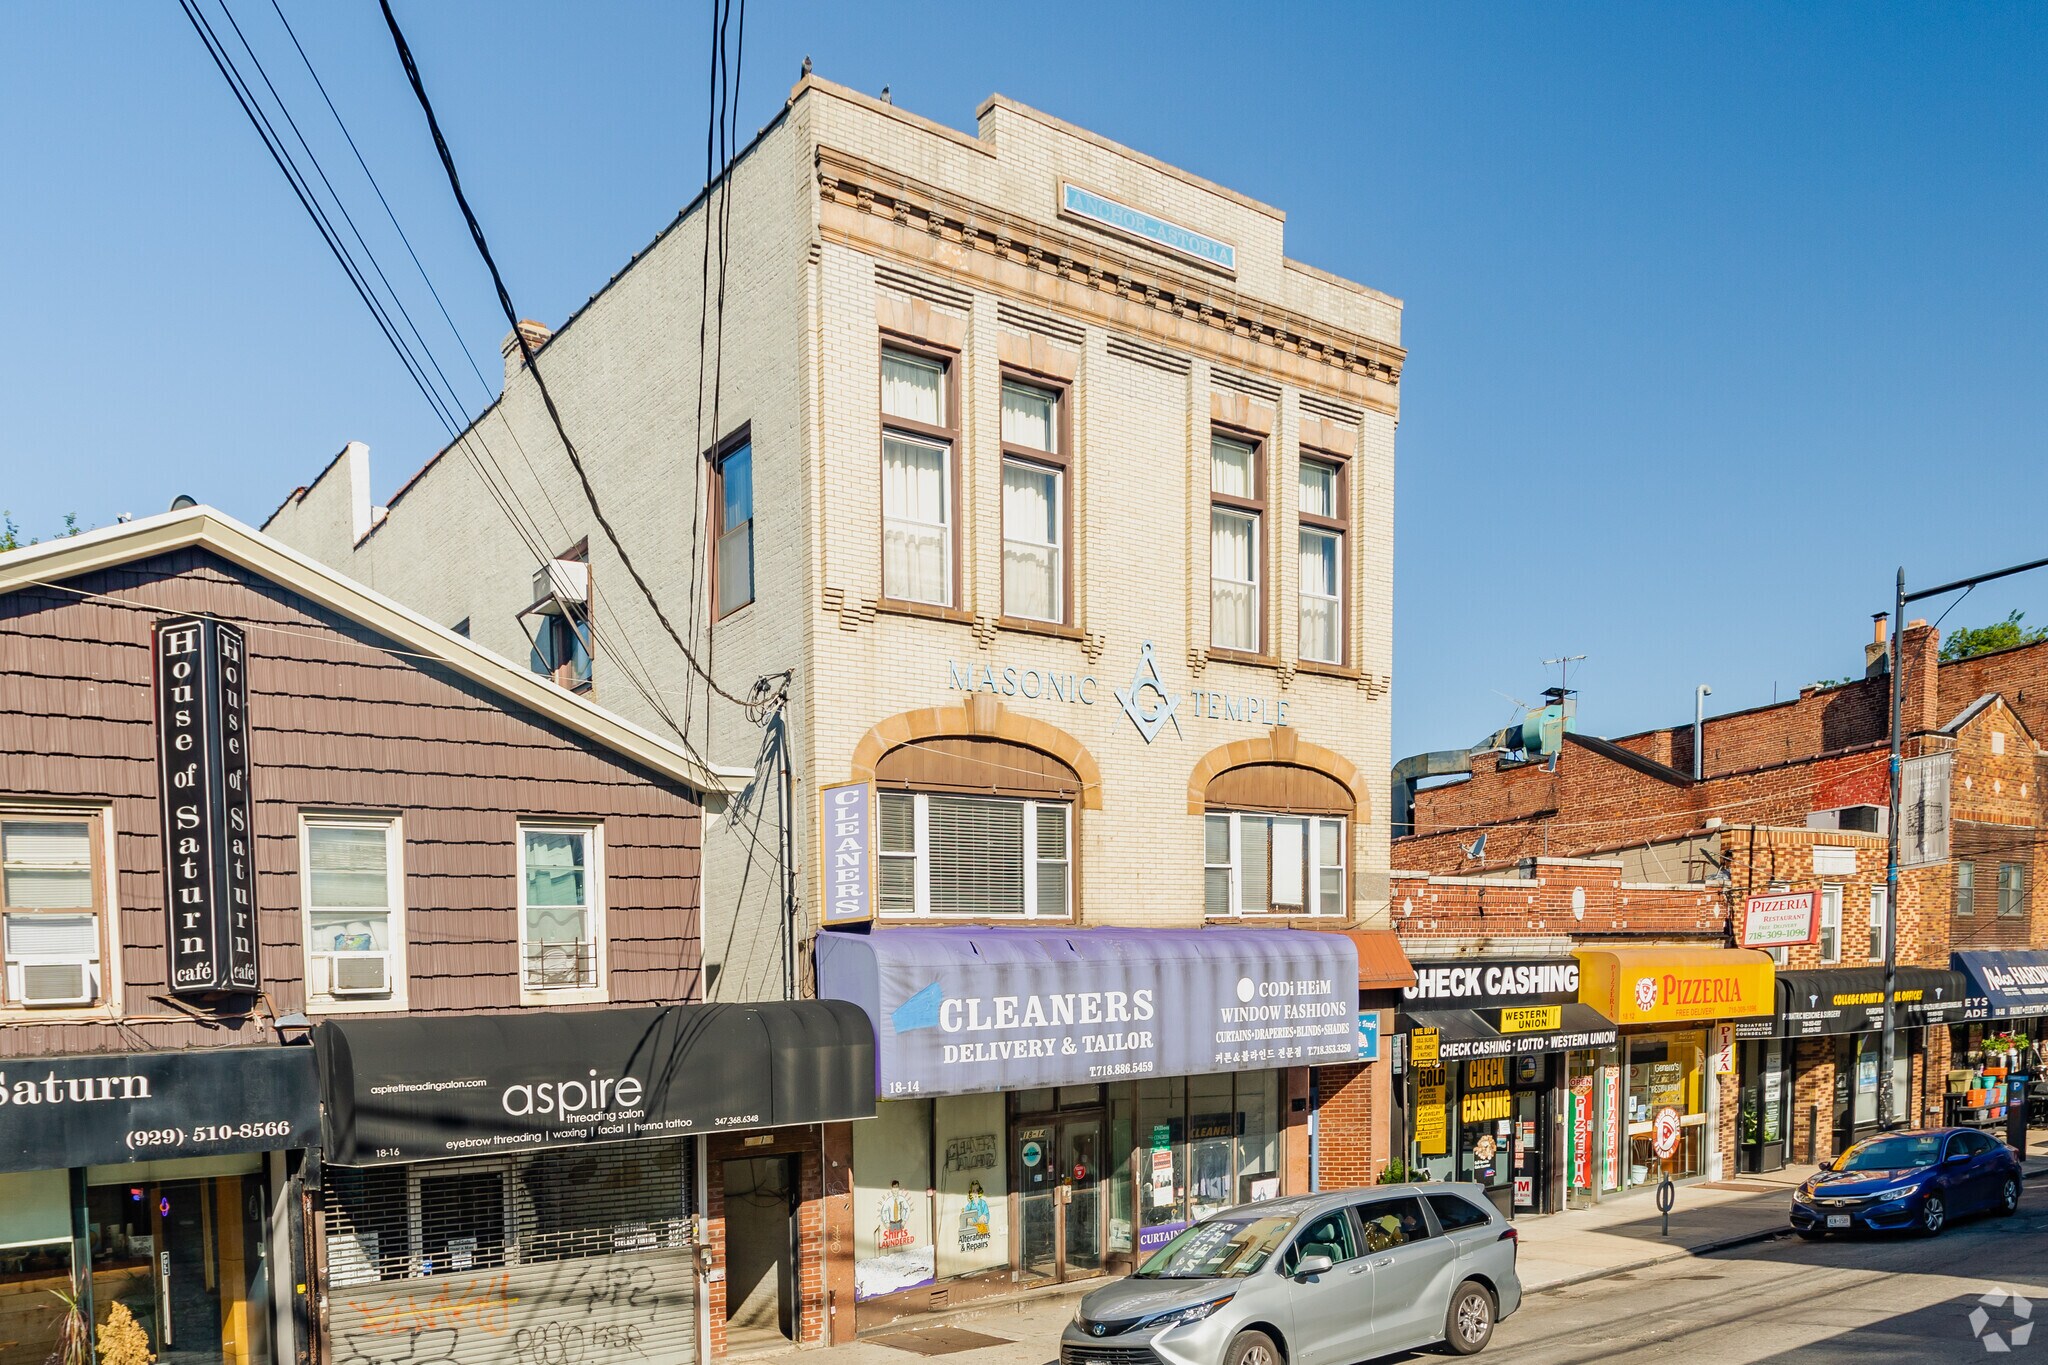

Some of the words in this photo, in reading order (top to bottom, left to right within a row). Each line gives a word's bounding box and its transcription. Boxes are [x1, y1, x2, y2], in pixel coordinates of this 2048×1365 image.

[165, 628, 199, 751] House
[220, 634, 241, 755] House
[948, 659, 1097, 705] MASONIC
[1192, 689, 1290, 726] TEMPLE
[174, 764, 198, 788] of
[229, 769, 242, 791] of
[834, 790, 864, 914] CLEANERS
[175, 805, 206, 954] Saturn
[229, 808, 251, 953] Saturn
[1751, 898, 1808, 913] PIZZERIA
[177, 961, 212, 982] café
[233, 964, 255, 981] café
[1485, 965, 1578, 995] CASHING
[1662, 974, 1742, 1006] PIZZERIA
[1833, 993, 1859, 1006] COLLEGE
[1860, 992, 1878, 1005] POINT
[940, 989, 1154, 1033] CLEANERS
[1221, 1005, 1281, 1023] WINDOW
[1284, 1002, 1346, 1020] FASHIONS
[1505, 1009, 1548, 1020] WESTERN
[1414, 1027, 1423, 1035] WE
[1518, 1019, 1547, 1029] UNION
[943, 1037, 1057, 1064] DELIVERY
[1061, 1037, 1078, 1055] &
[1082, 1031, 1154, 1053] TAILOR
[1440, 1042, 1471, 1058] CHECK
[1472, 1039, 1511, 1055] CASHING
[1517, 1037, 1544, 1051] LOTTO
[1551, 1033, 1589, 1048] WESTERN
[1590, 1031, 1615, 1046] UNION
[1719, 1026, 1731, 1071] PIZZA
[1089, 1061, 1153, 1077] T.718.886.5459
[1420, 1069, 1445, 1087] GOLD
[1469, 1058, 1505, 1089] CHECK
[371, 1078, 486, 1095] aspirethreadingsalon.com
[502, 1069, 642, 1122] aspire
[889, 1081, 920, 1094] 18-14
[566, 1110, 616, 1123] threading
[618, 1108, 644, 1120] salon
[1462, 1089, 1511, 1123] CASHING
[126, 1127, 184, 1150] (929)
[192, 1121, 290, 1142] 510-8566
[446, 1136, 491, 1150] eyebrow
[493, 1131, 542, 1146] threading
[552, 1126, 587, 1141] waxing
[598, 1123, 624, 1135] facial
[634, 1120, 663, 1132] henna
[665, 1117, 693, 1128] tattoo
[1574, 1099, 1586, 1184] PIZZERIA
[1606, 1084, 1616, 1184] PIZZERIA
[375, 1147, 400, 1158] 18-16
[878, 1235, 915, 1249] LAUNDERED
[883, 1227, 908, 1240] Shirts
[958, 1231, 990, 1244] Alterations
[961, 1243, 966, 1252] &
[966, 1240, 989, 1252] Repairs
